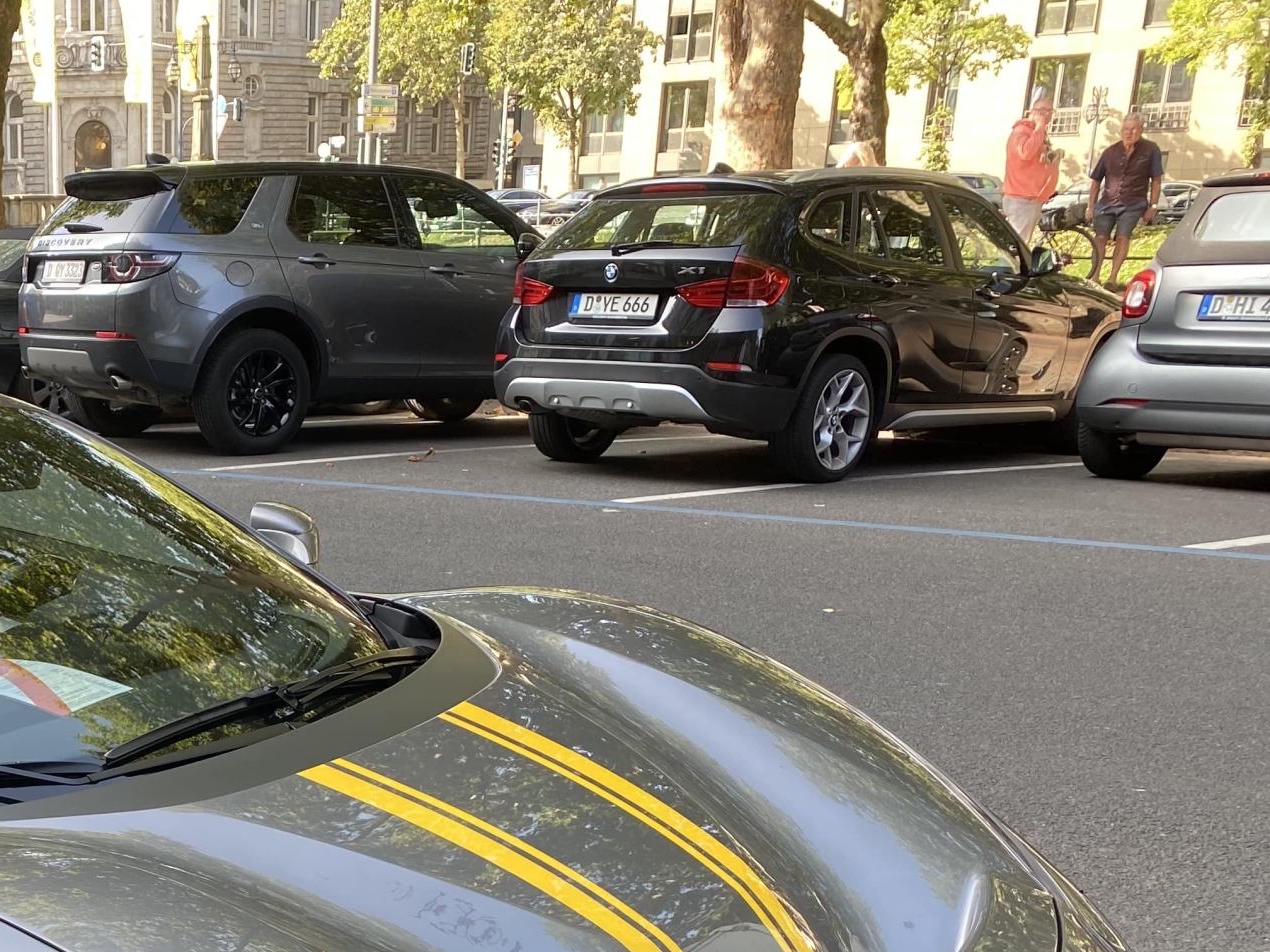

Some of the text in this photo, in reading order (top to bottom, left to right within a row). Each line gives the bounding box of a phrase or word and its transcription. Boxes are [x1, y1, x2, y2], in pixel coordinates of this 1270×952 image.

[37, 239, 92, 247] DISCOVERY
[677, 266, 706, 275] X1
[583, 296, 650, 313] D YE 666
[1209, 296, 1225, 315] D
[1232, 296, 1258, 315] HI
